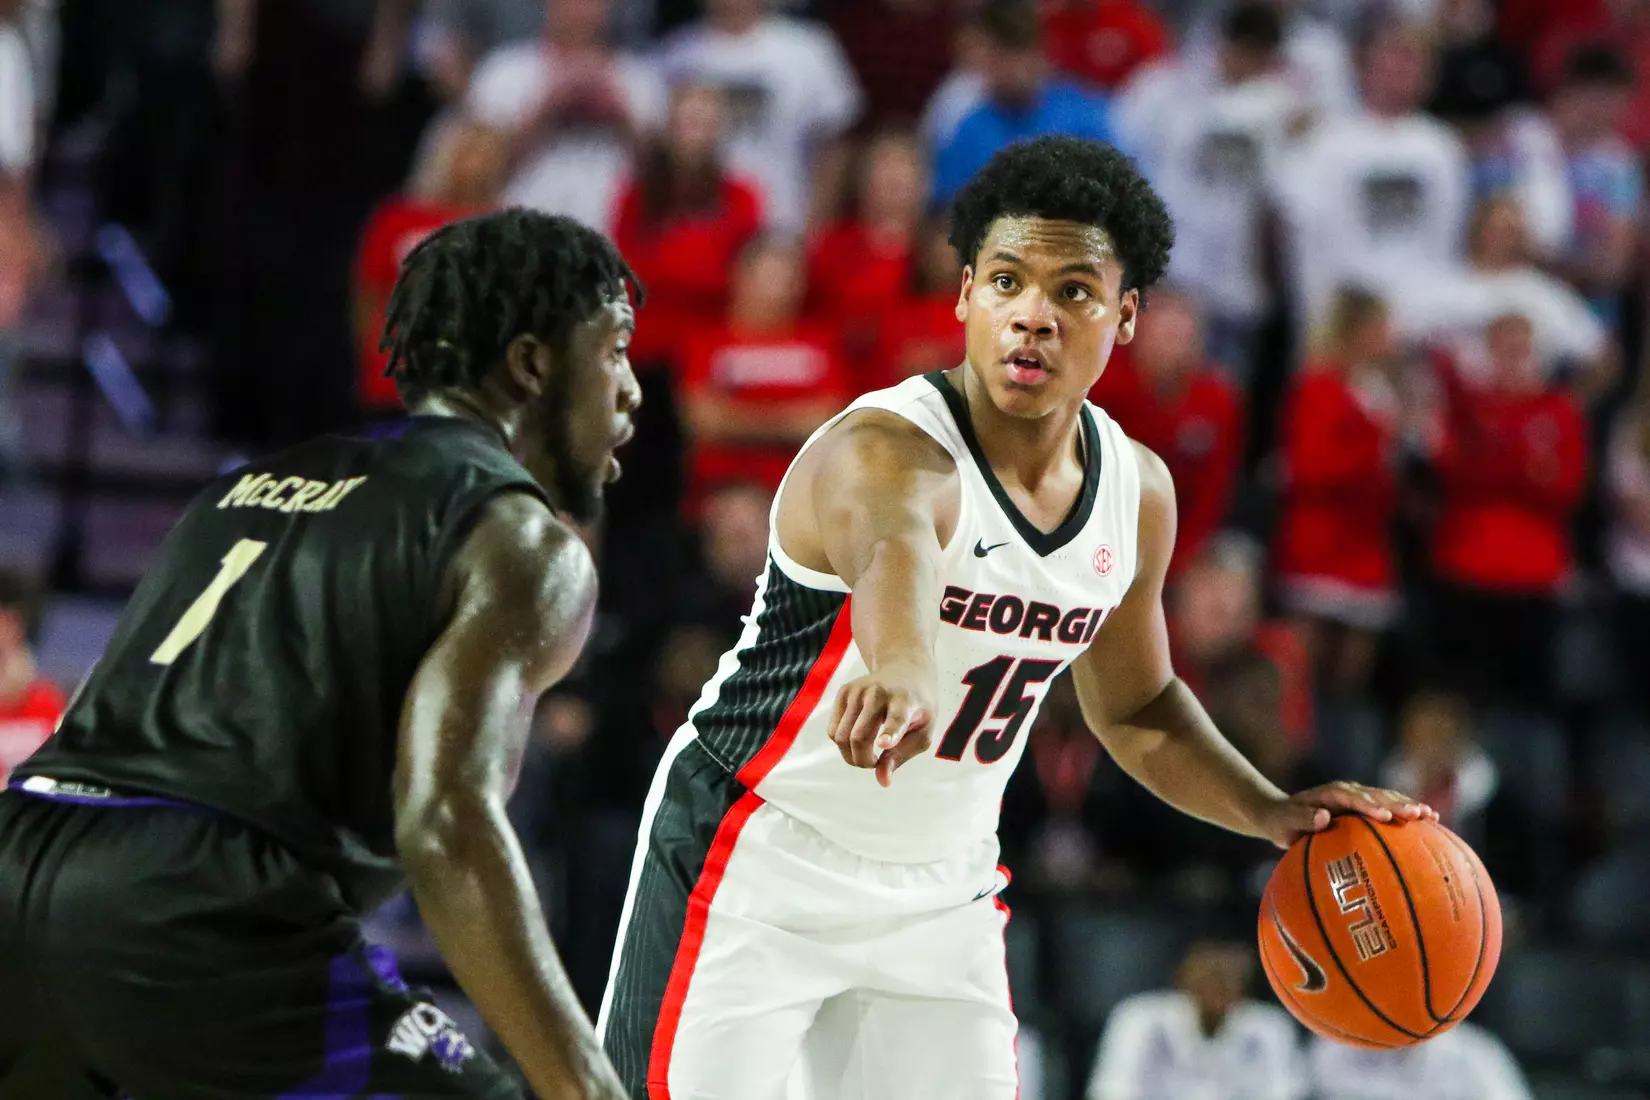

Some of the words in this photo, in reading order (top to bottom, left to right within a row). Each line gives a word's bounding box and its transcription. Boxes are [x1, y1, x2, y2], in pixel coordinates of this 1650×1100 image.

[217, 473, 367, 512] McCRAY
[150, 538, 268, 665] 1
[1095, 547, 1113, 574] SEC
[935, 654, 1063, 764] 15
[1326, 855, 1389, 962] ELITE
